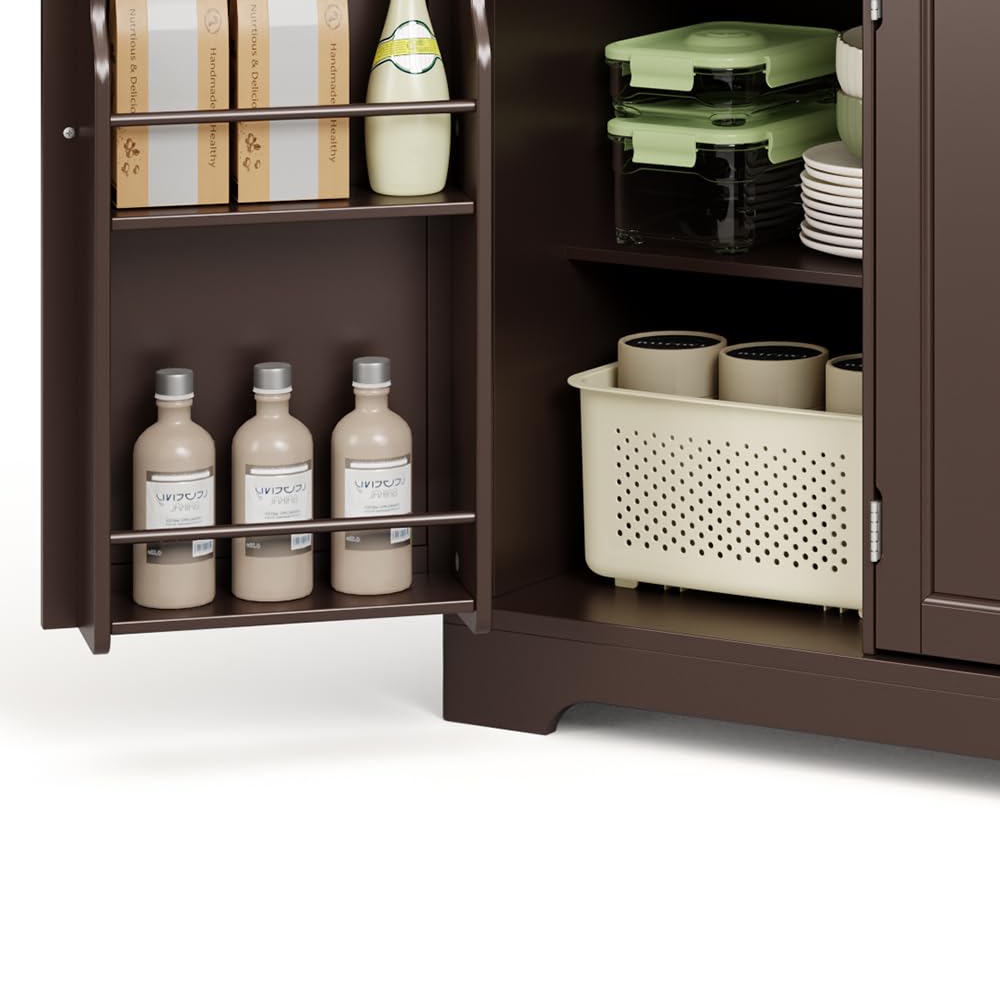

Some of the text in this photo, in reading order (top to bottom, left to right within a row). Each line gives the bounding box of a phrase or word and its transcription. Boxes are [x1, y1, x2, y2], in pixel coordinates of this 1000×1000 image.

[130, 64, 138, 72] &
[251, 59, 259, 68] &
[130, 76, 138, 113] Delicio
[208, 48, 217, 168] Handmade Healthy
[251, 71, 259, 109] Delicio
[329, 119, 337, 163] Healthy
